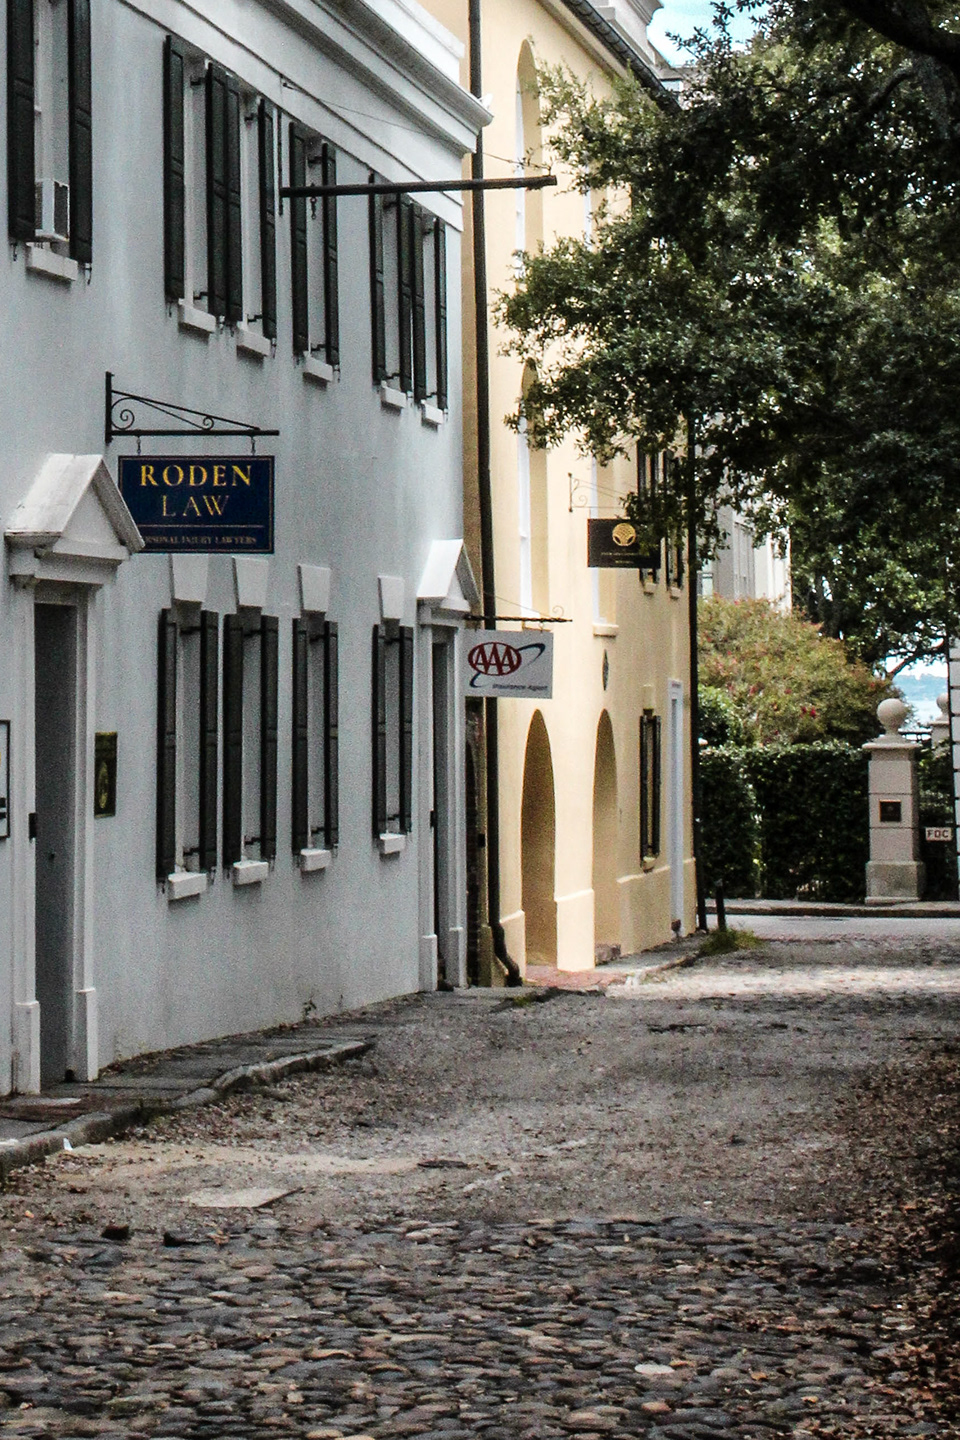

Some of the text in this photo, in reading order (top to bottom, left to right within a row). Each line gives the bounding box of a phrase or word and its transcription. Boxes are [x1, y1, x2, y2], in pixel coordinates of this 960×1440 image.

[140, 464, 252, 486] RODEN
[162, 494, 229, 516] LAW
[214, 535, 257, 545] LAWYERS
[474, 644, 517, 675] AAA
[927, 829, 949, 838] FDC
